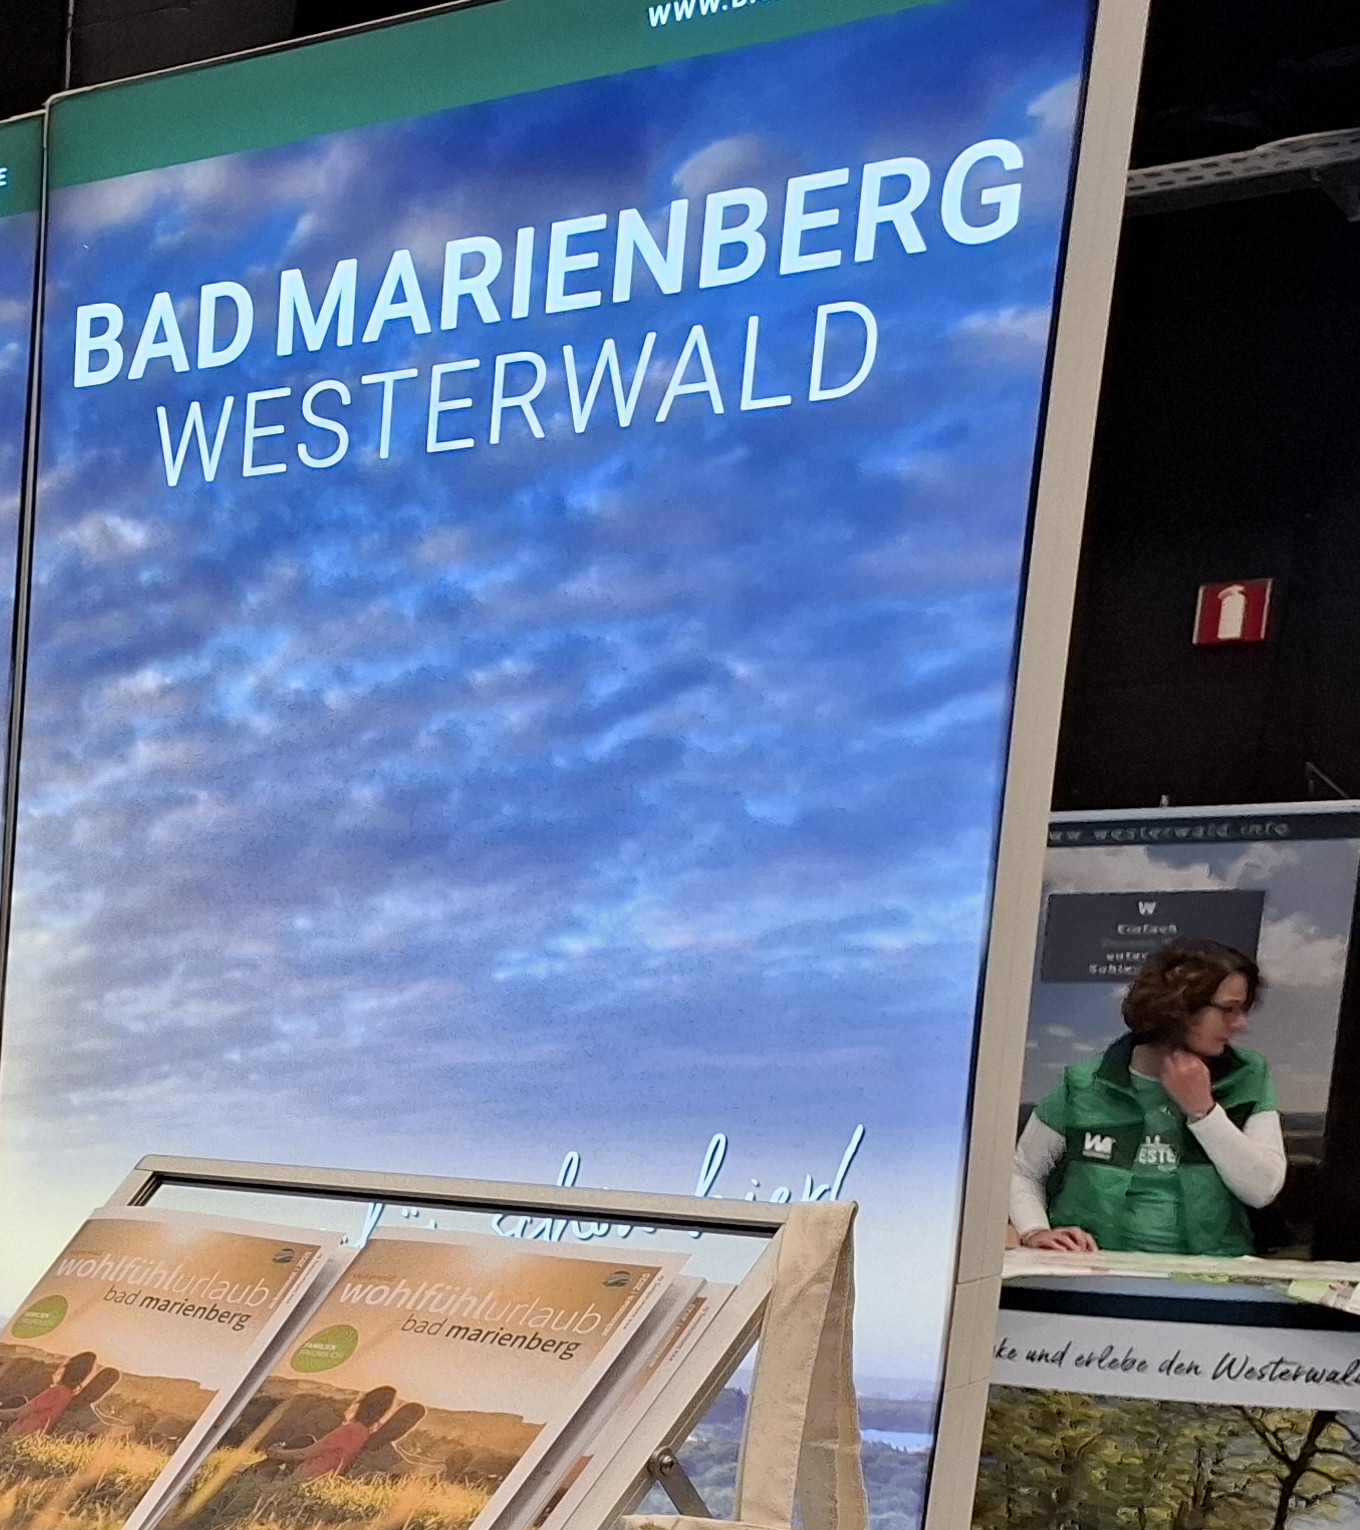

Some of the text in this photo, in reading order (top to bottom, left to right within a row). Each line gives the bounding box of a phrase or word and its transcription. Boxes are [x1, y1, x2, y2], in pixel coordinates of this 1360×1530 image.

[73, 137, 1025, 388] BAD MARIENBERG
[156, 299, 880, 488] WESTERWALD
[55, 1253, 270, 1308] wohlfühlurlaub
[338, 1279, 603, 1336] wohlfühlurlaub
[104, 1285, 252, 1332] bad marienberg
[400, 1313, 584, 1361] bad marienberg
[1025, 1341, 1074, 1369] und
[1075, 1346, 1150, 1375] erlebe
[1158, 1349, 1203, 1377] den
